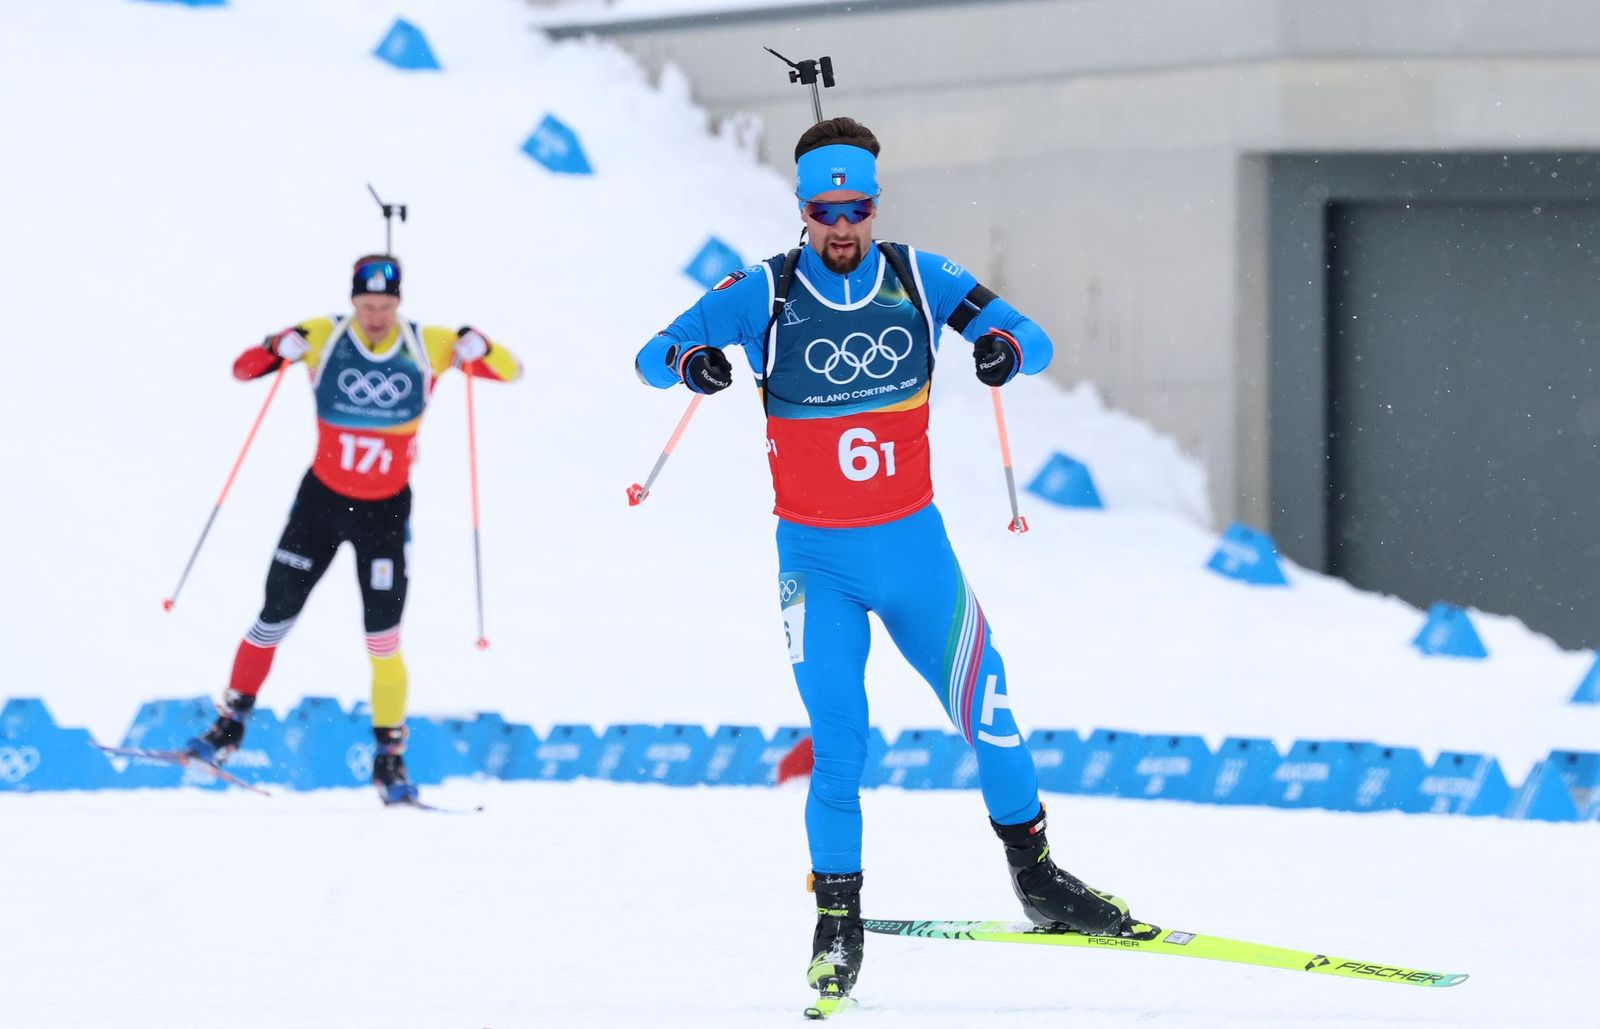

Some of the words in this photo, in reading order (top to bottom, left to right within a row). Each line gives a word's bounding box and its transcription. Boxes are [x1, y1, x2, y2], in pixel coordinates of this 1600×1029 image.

[803, 392, 850, 403] MILANO
[852, 384, 898, 398] CORTINA
[817, 907, 849, 917] CHER
[1088, 937, 1140, 948] FISCHER
[1334, 961, 1444, 984] FISCHER
